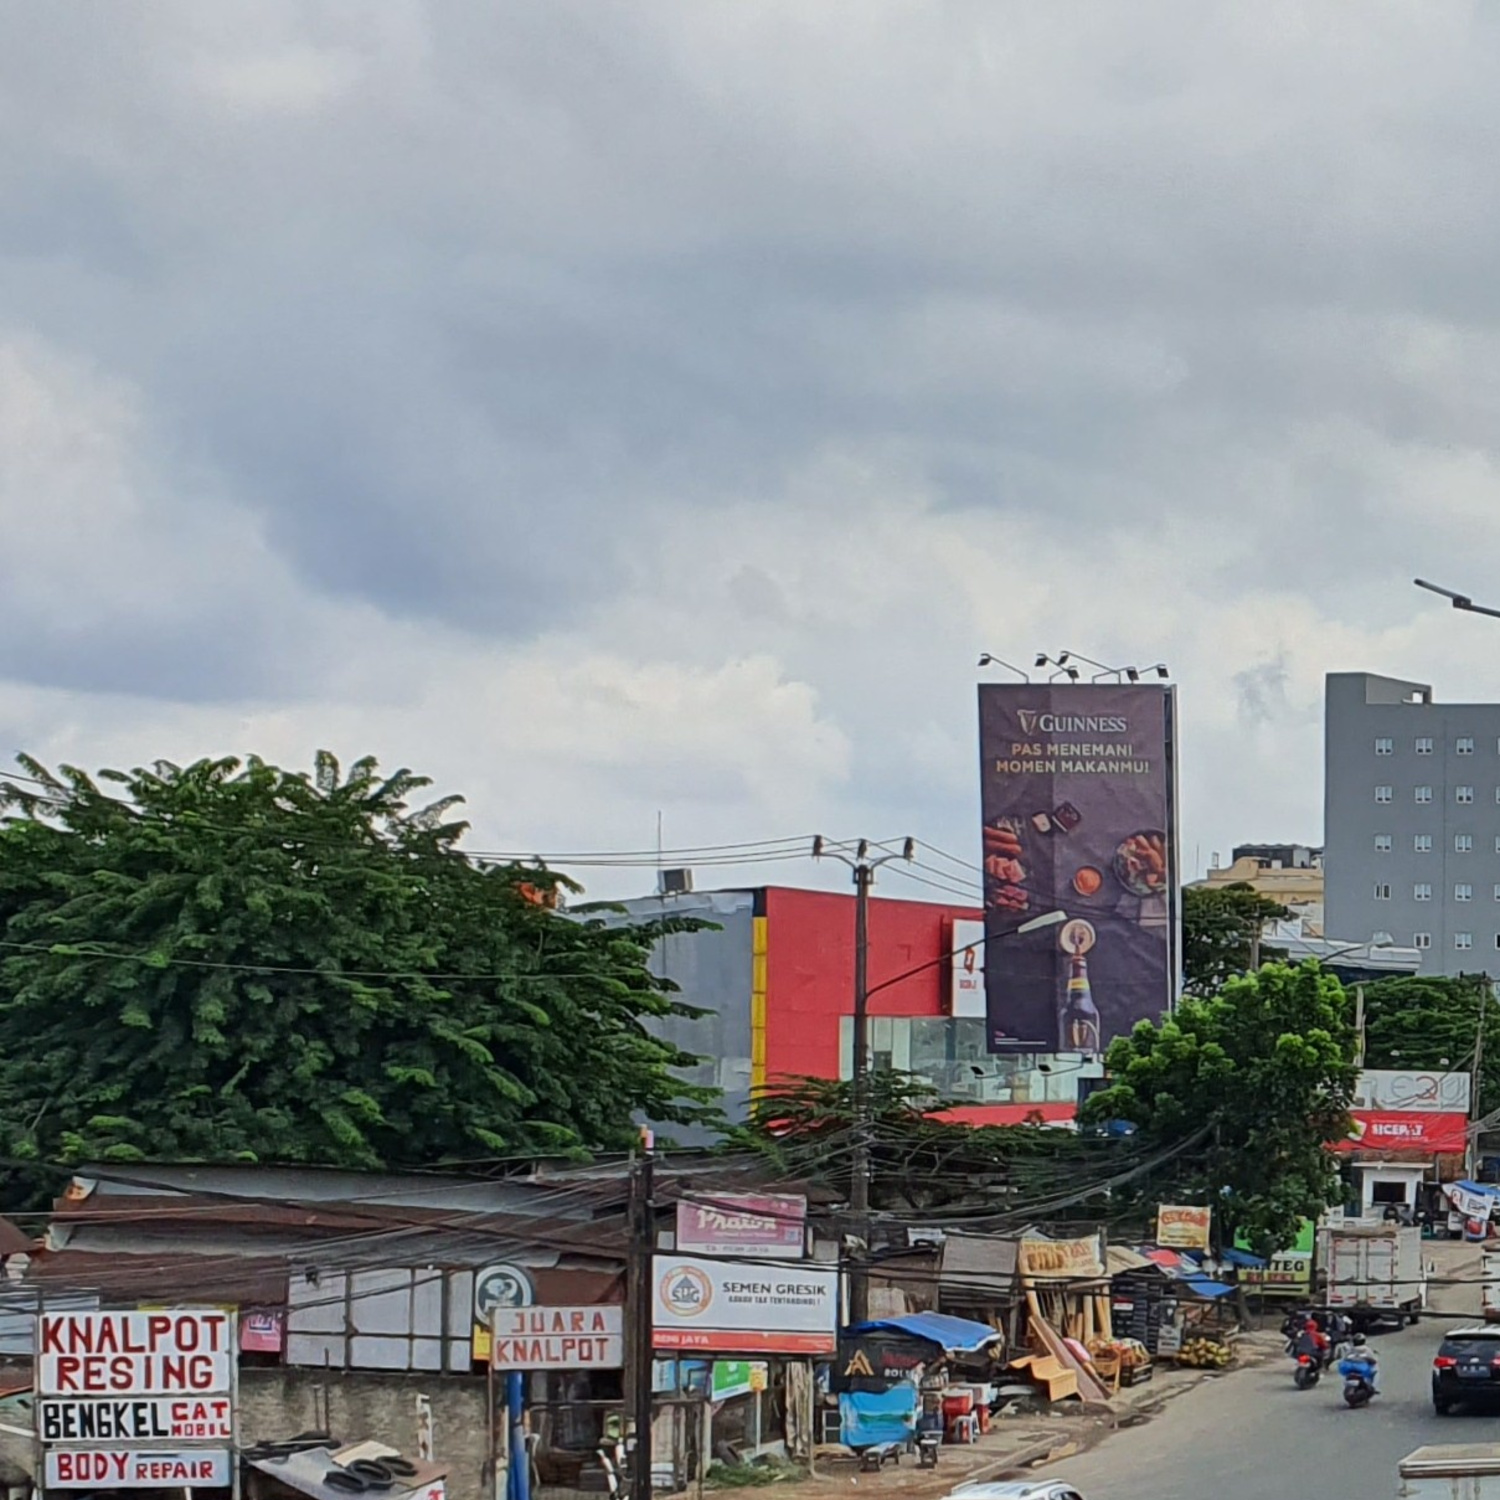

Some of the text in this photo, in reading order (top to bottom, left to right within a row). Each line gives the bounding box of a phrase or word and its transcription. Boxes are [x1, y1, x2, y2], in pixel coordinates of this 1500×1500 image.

[1039, 714, 1127, 732] GUINNESS
[1011, 743, 1133, 757] PAS MENEMANI
[996, 760, 1149, 773] MOMEN MAKANMU!
[722, 1282, 826, 1295] SEMEN GRESIK
[511, 1312, 606, 1333] JUARA
[42, 1315, 226, 1354] KNALPOT
[681, 1335, 709, 1345] JAYA
[497, 1338, 609, 1363] KNALPOT
[57, 1355, 213, 1391] RESING
[43, 1400, 228, 1438] BENGKEL CAT
[171, 1423, 230, 1436] MOBIL
[57, 1452, 213, 1481] BODY REPAIR
